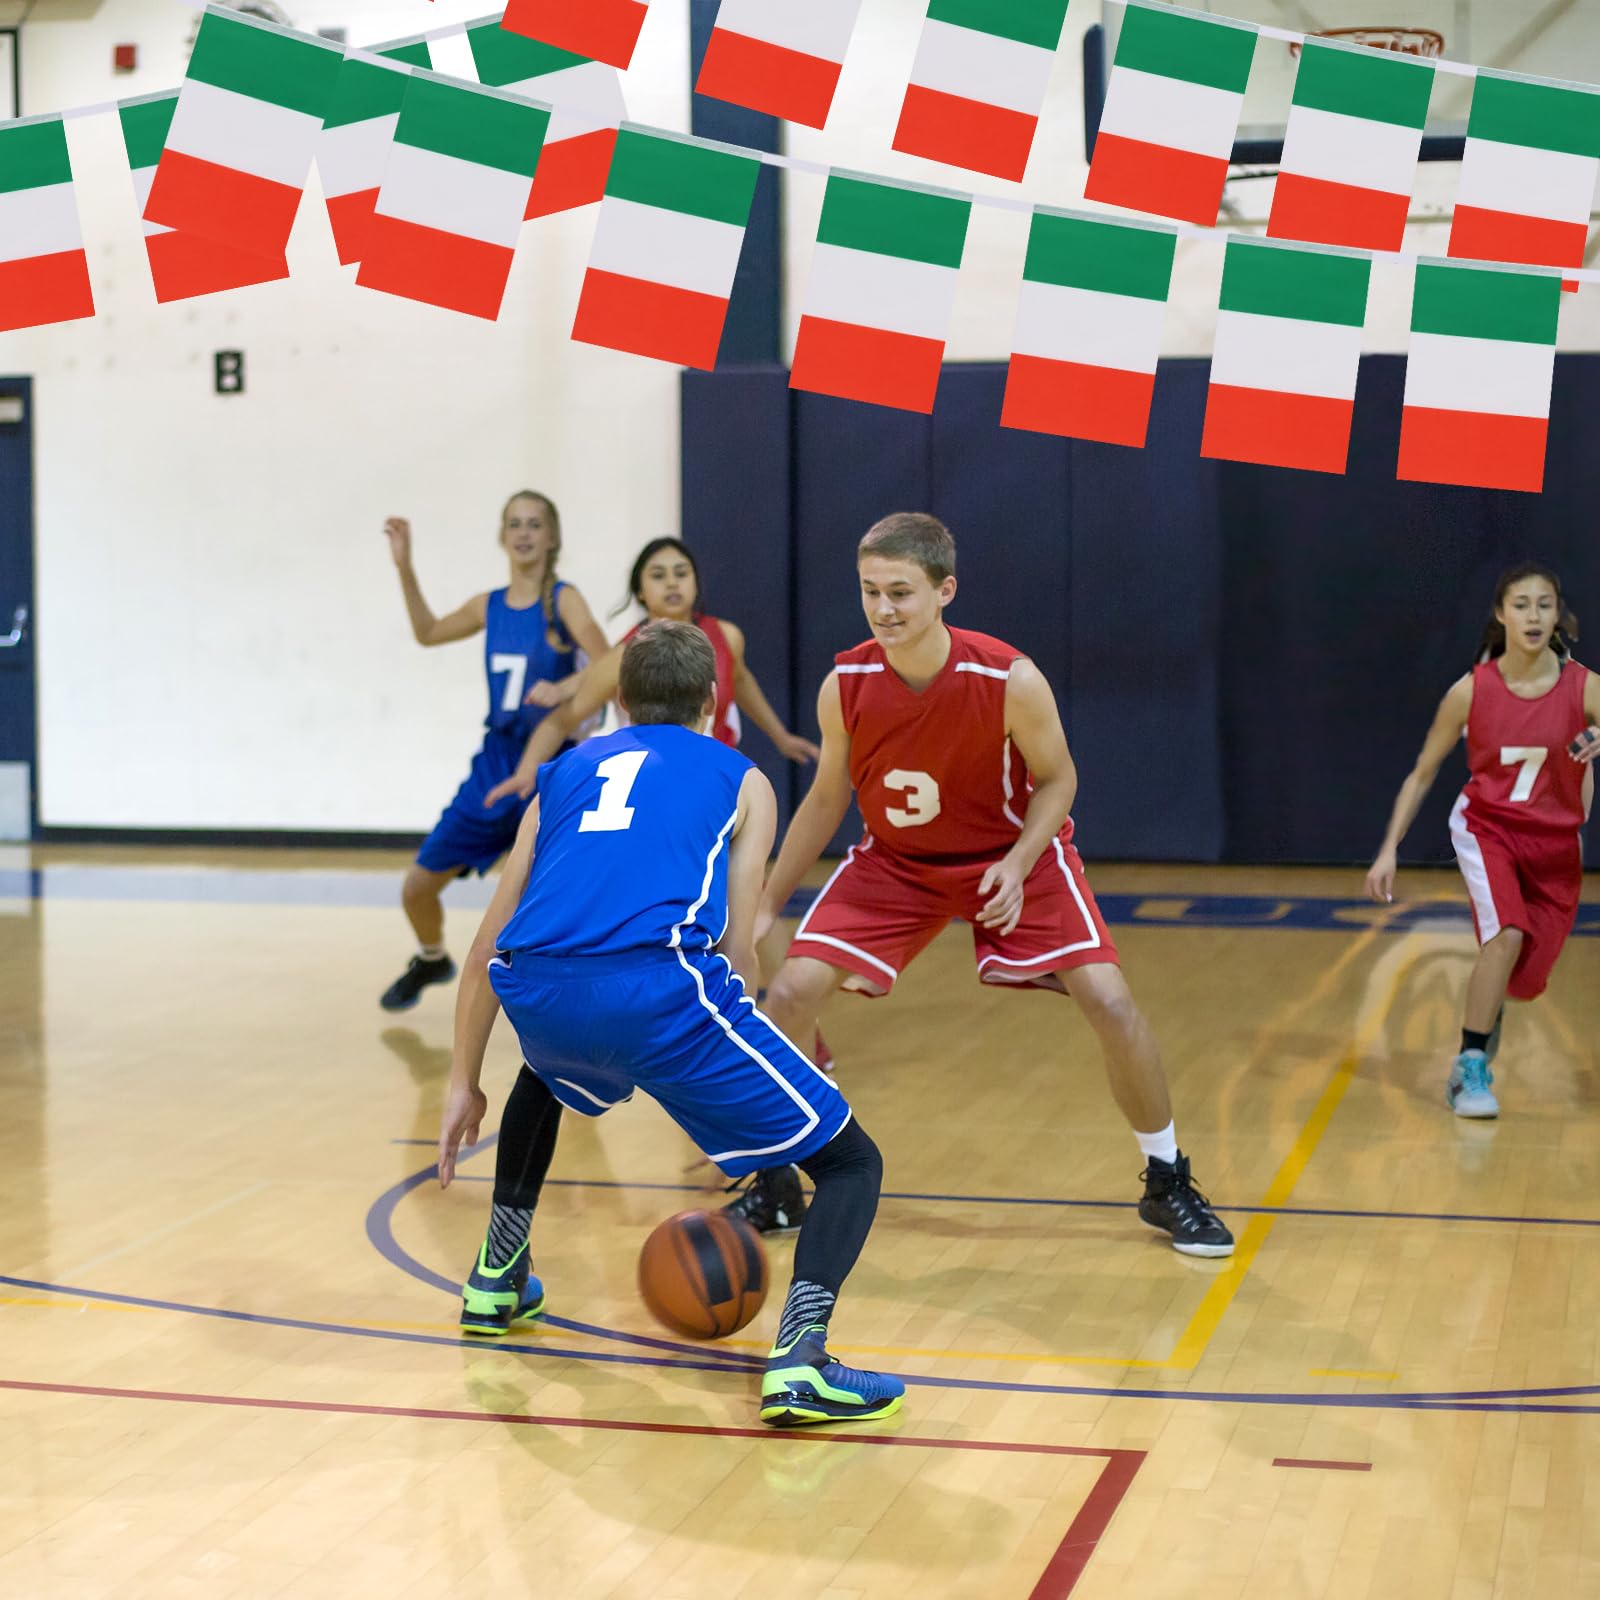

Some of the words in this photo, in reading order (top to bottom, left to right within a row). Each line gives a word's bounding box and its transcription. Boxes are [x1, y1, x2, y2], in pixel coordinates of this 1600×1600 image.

[214, 351, 244, 393] B
[491, 654, 527, 711] 7
[578, 750, 649, 833] 1
[883, 768, 941, 829] 3
[1500, 746, 1548, 802] 7
